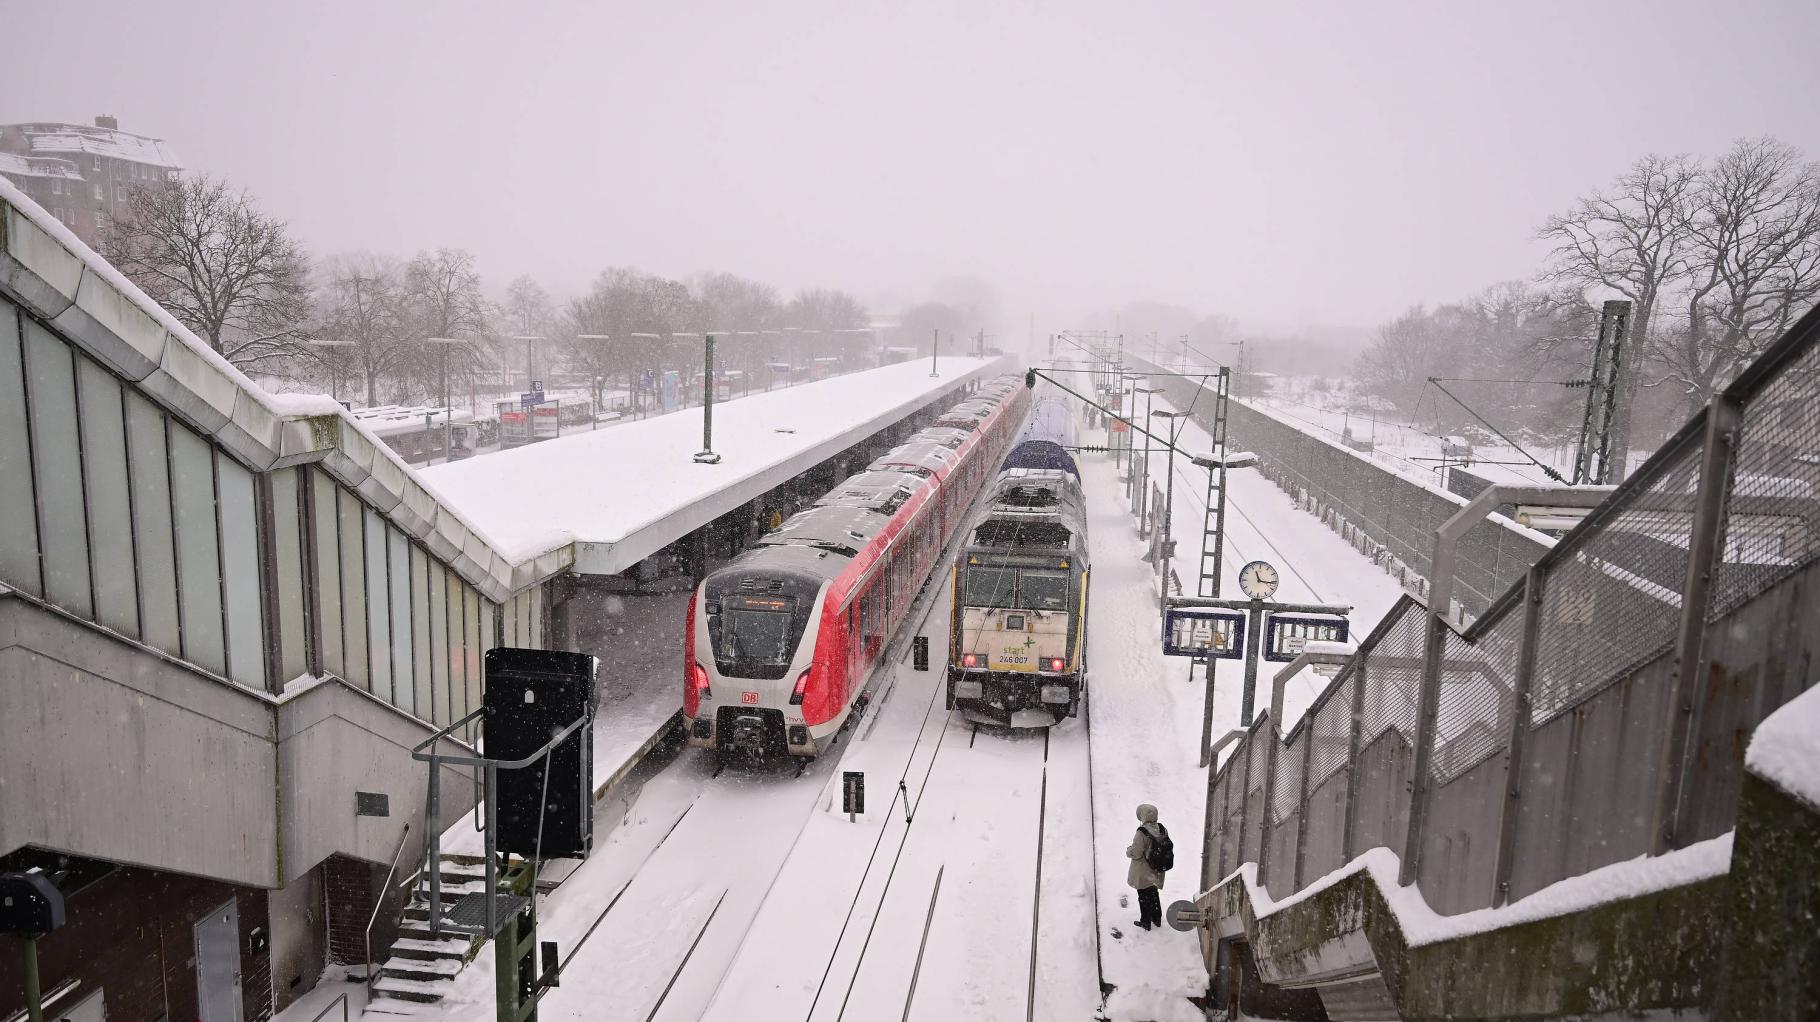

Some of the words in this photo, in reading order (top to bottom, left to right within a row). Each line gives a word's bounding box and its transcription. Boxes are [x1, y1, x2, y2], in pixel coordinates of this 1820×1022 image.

[535, 382, 542, 390] B
[1003, 646, 1025, 655] start
[999, 655, 1013, 663] 246
[1014, 656, 1028, 664] 007
[743, 693, 758, 704] DB
